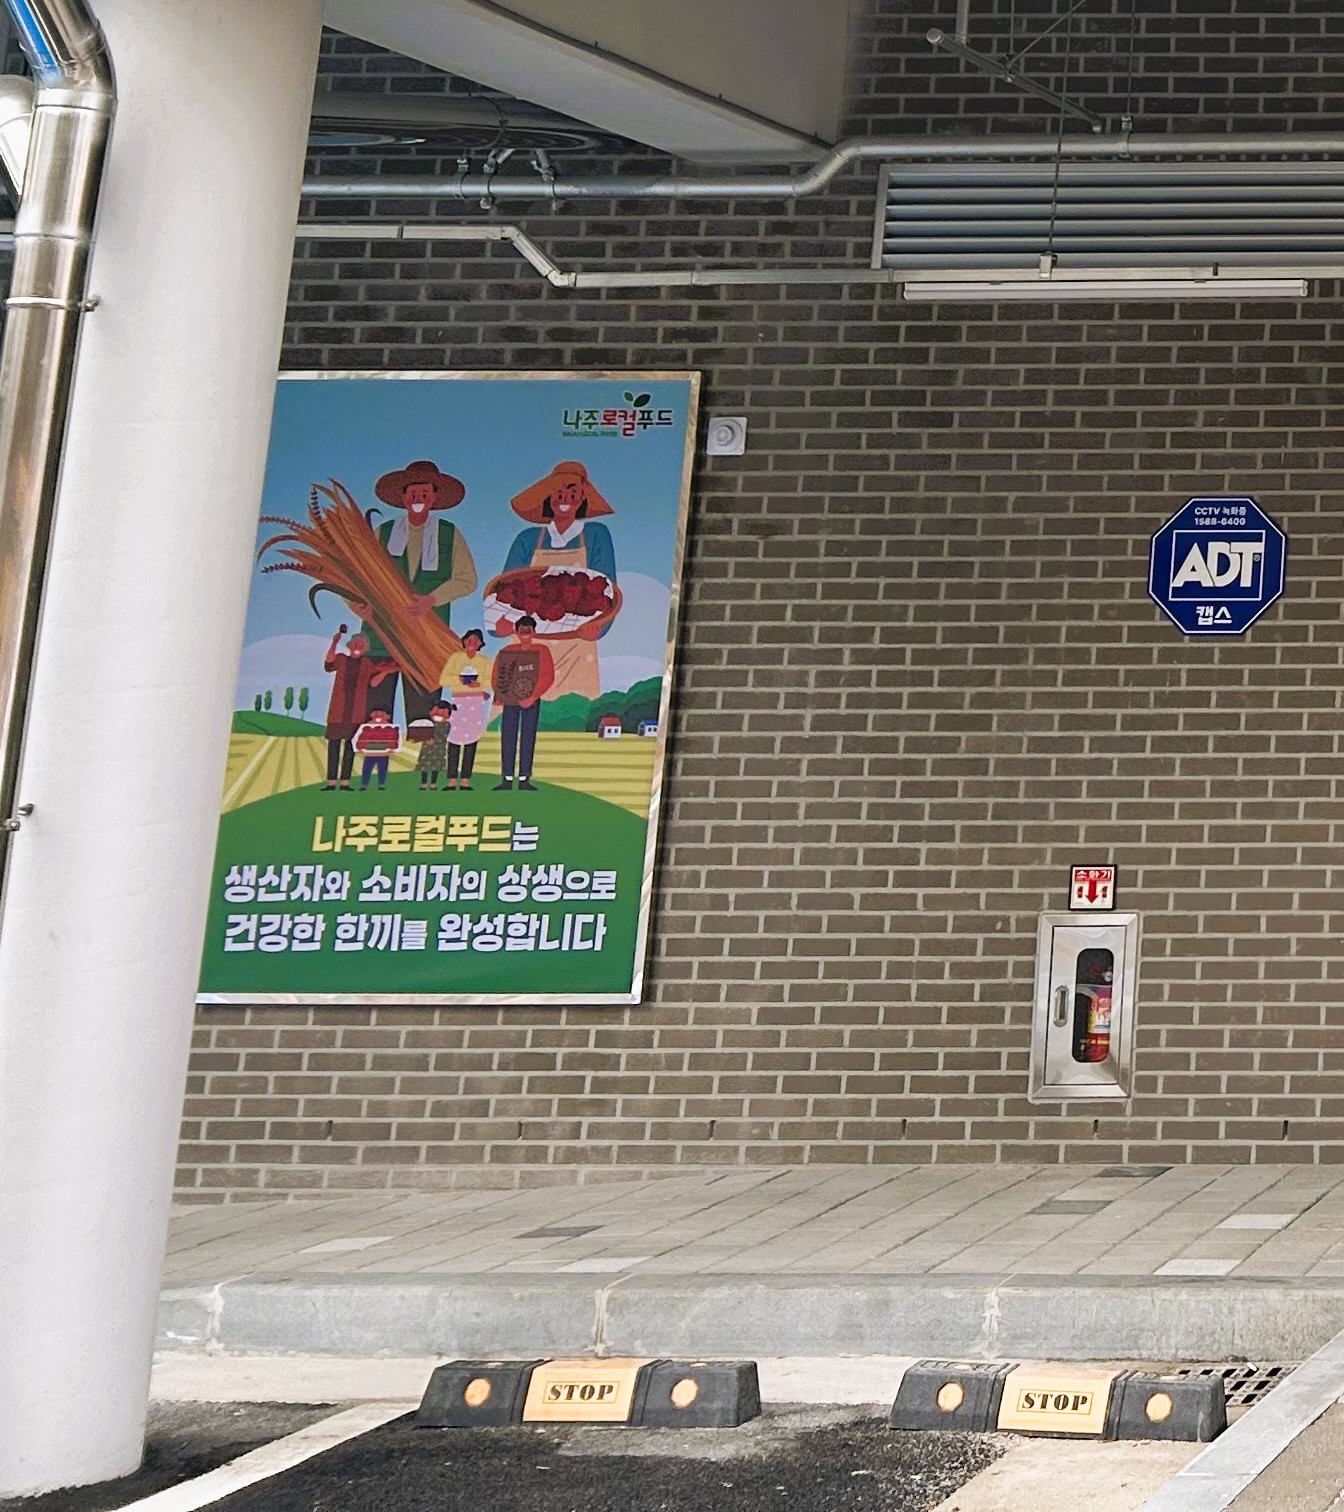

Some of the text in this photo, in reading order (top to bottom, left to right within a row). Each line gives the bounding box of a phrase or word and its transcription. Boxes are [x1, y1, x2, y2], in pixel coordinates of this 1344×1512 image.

[562, 408, 674, 438] 나주로컬푸드
[1194, 506, 1221, 516] CCTV
[1194, 517, 1247, 526] 1588-6400
[1171, 541, 1264, 588] ADT
[1195, 605, 1233, 626] 캡스
[311, 815, 540, 853] 나주로컬푸드는
[223, 863, 618, 903] 생산자와 소비자의 상생으로
[1075, 869, 1112, 881] 소화기
[223, 912, 608, 953] 건강한 한끼를 완성합니다
[547, 1382, 614, 1403] STOP
[1022, 1391, 1090, 1412] STOP
